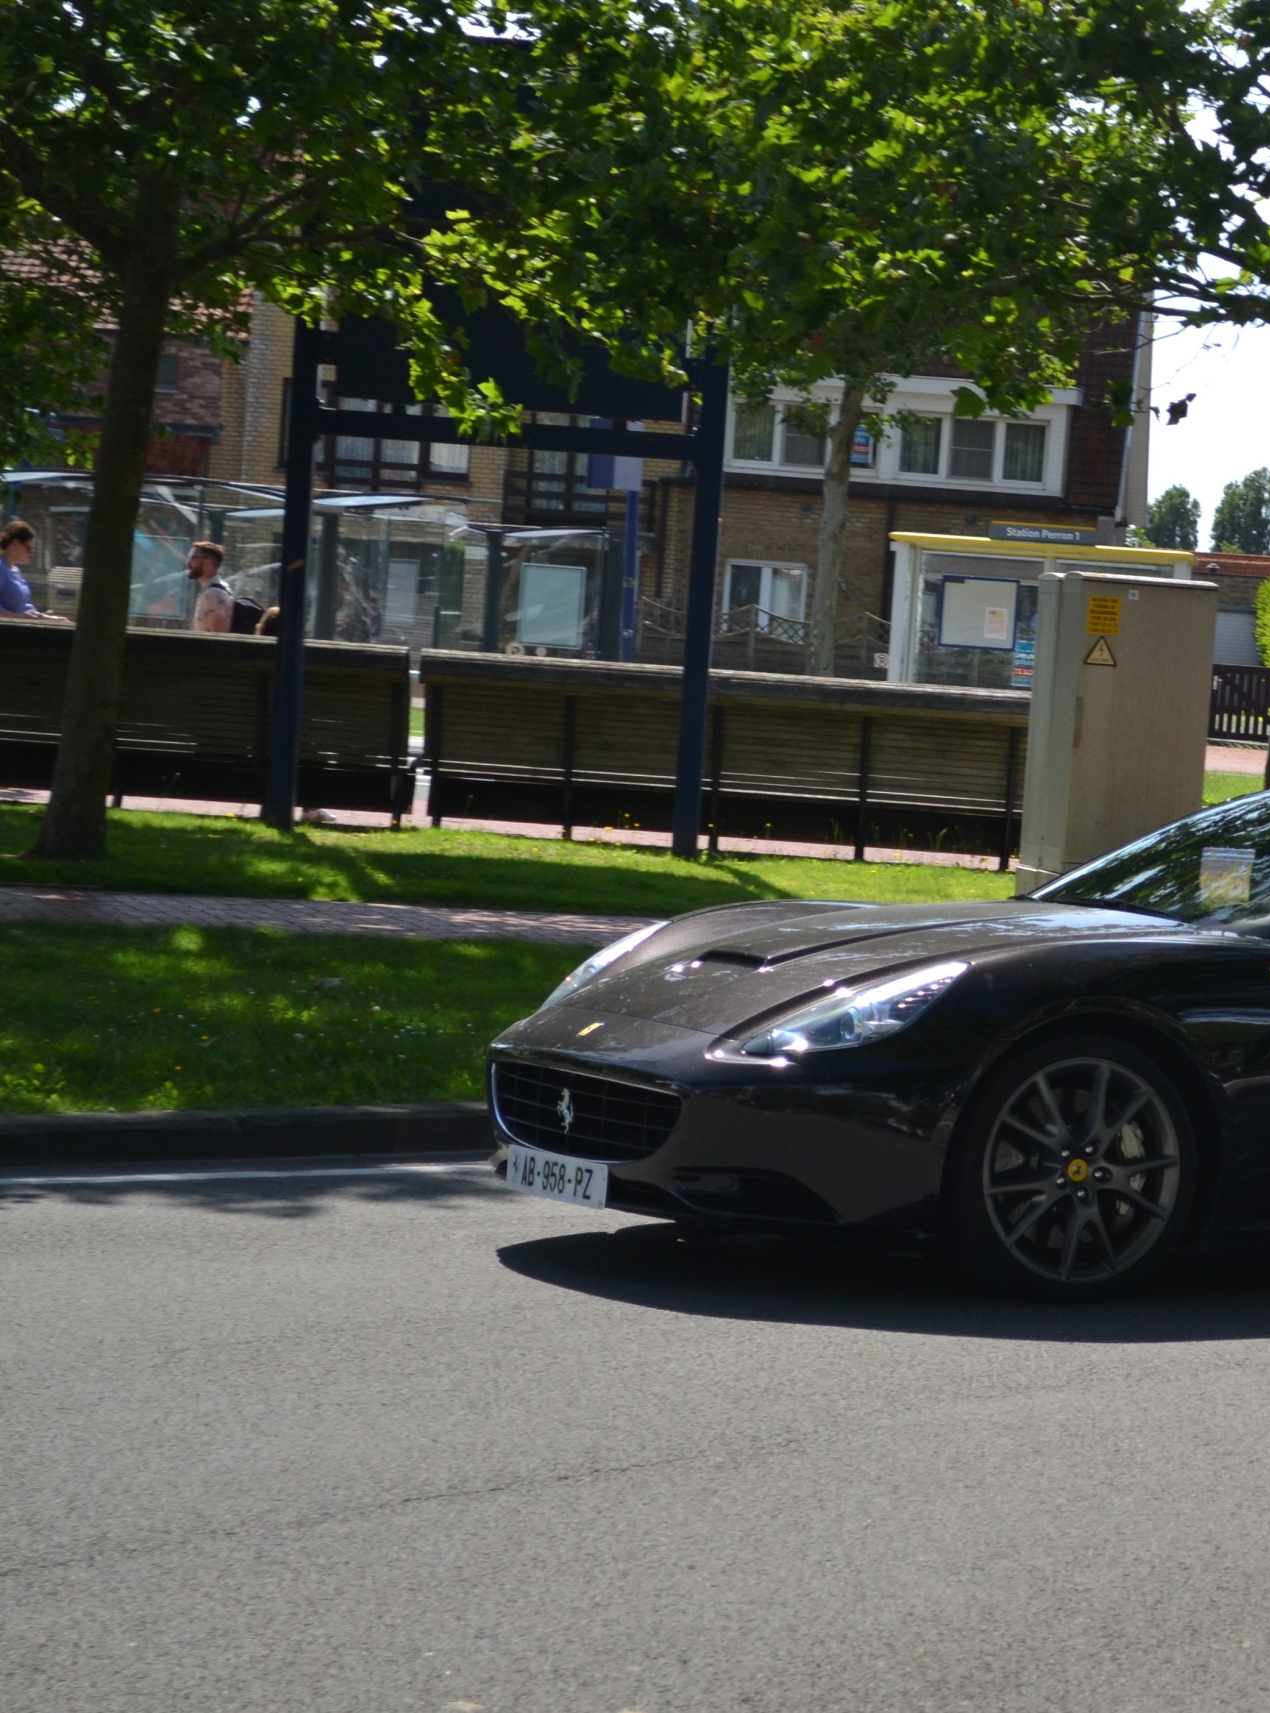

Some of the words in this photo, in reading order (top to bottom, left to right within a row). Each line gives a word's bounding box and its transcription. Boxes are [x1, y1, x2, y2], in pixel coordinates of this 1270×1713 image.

[1006, 527, 1040, 538] Station
[1041, 529, 1073, 540] Perron
[1074, 532, 1081, 541] 1
[521, 1155, 593, 1200] AB-958-PZ
